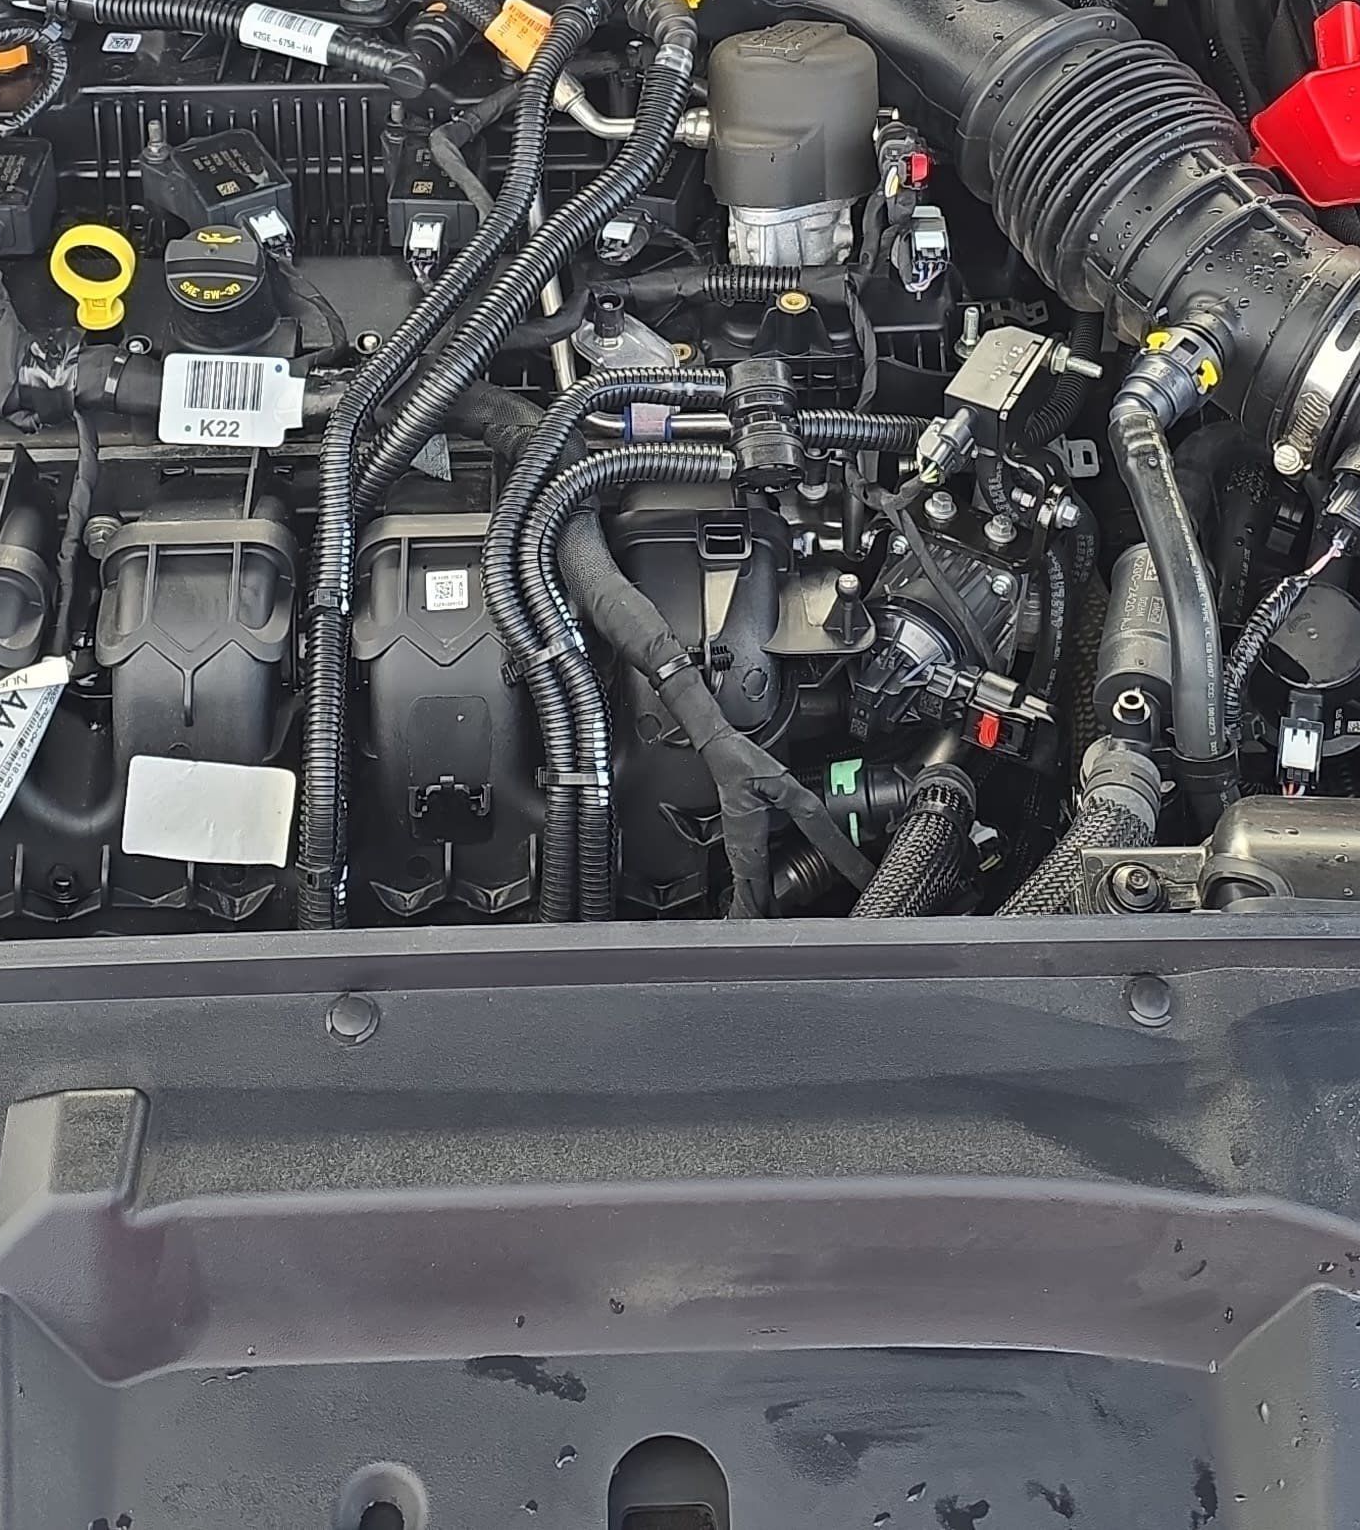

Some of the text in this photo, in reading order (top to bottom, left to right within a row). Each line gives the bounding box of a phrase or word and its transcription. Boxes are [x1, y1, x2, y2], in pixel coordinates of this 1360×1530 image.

[179, 281, 242, 300] SAE 5W-30
[200, 419, 241, 438] K22
